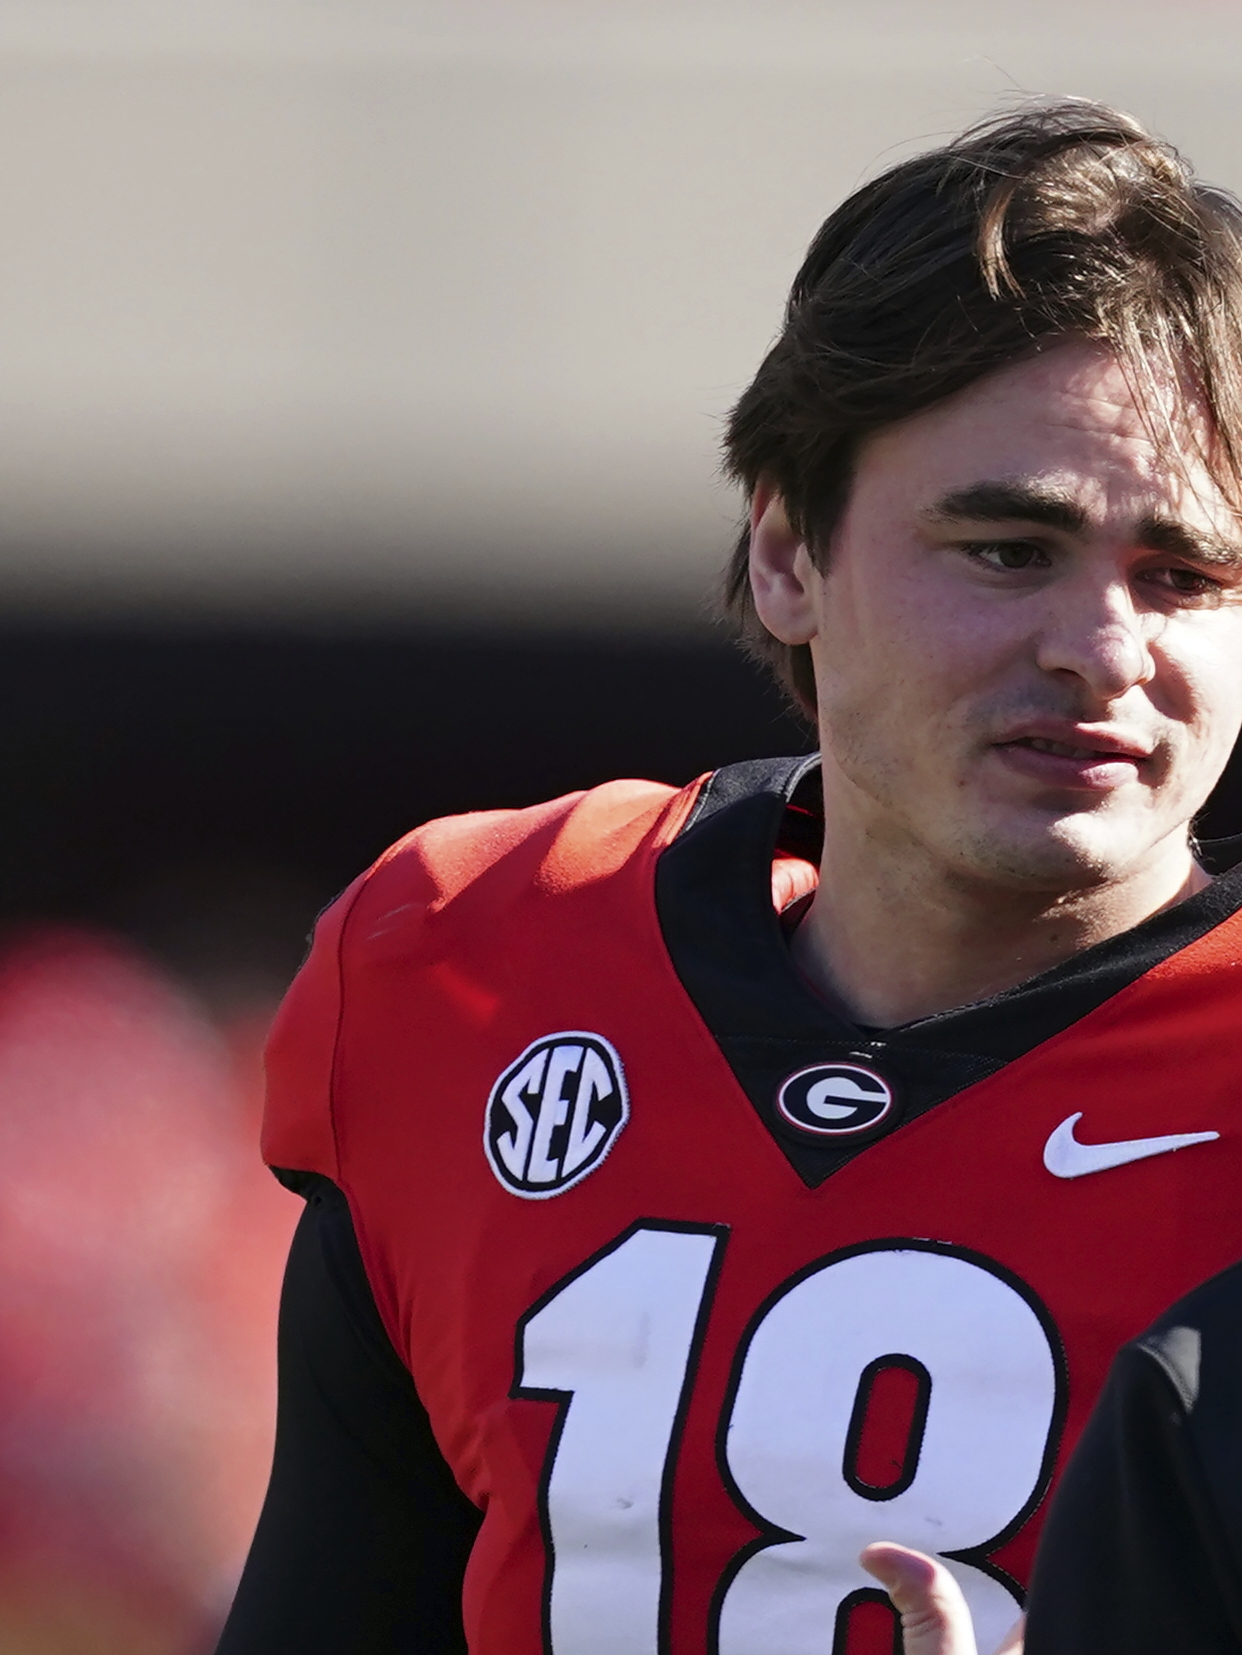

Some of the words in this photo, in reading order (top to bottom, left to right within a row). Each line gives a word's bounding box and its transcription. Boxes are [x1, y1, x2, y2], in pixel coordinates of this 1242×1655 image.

[496, 1045, 613, 1183] SEC
[780, 1065, 890, 1132] G
[511, 1220, 1066, 1655] 18
